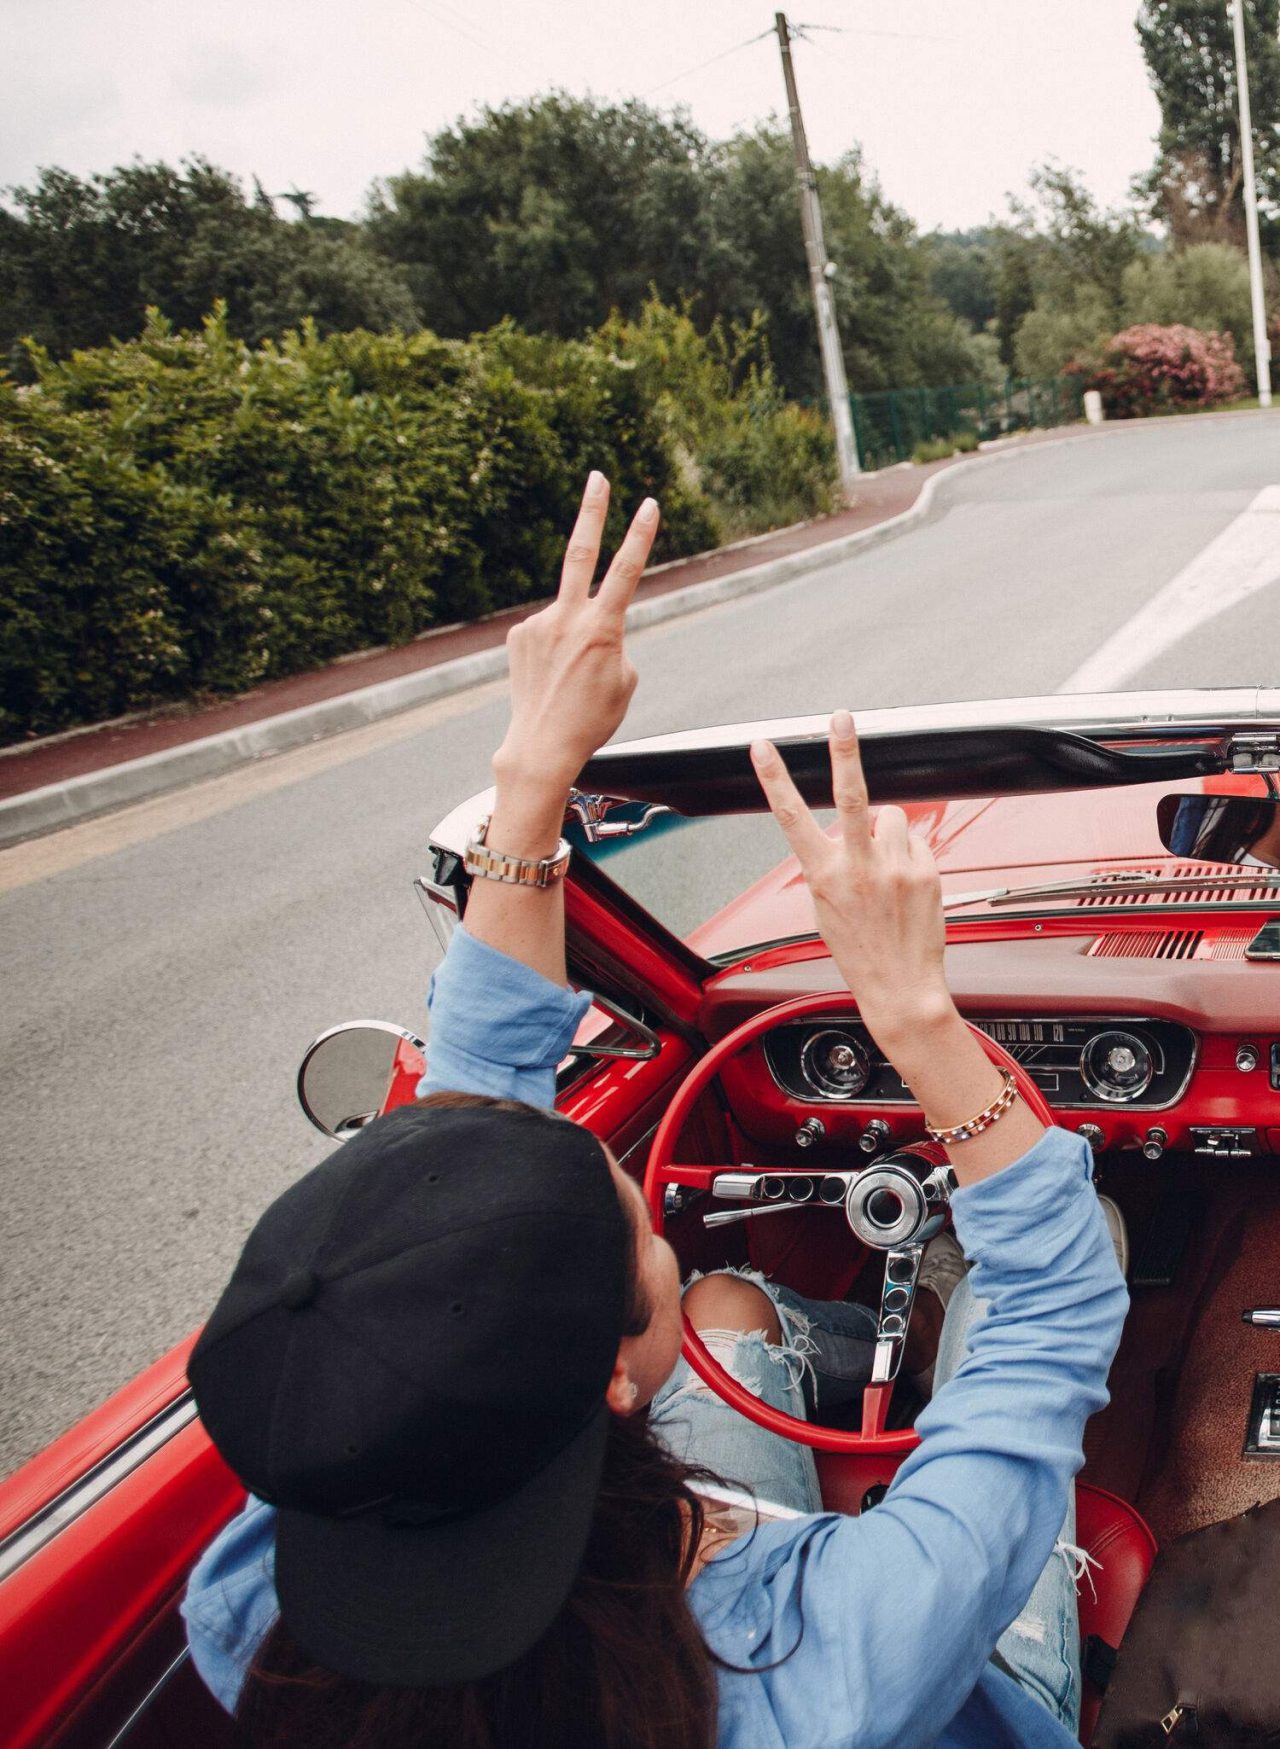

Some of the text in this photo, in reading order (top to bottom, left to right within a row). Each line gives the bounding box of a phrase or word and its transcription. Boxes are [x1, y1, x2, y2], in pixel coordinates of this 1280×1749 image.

[1019, 1024, 1030, 1041] 100
[1033, 1023, 1044, 1042] 110
[1052, 1024, 1064, 1042] 120
